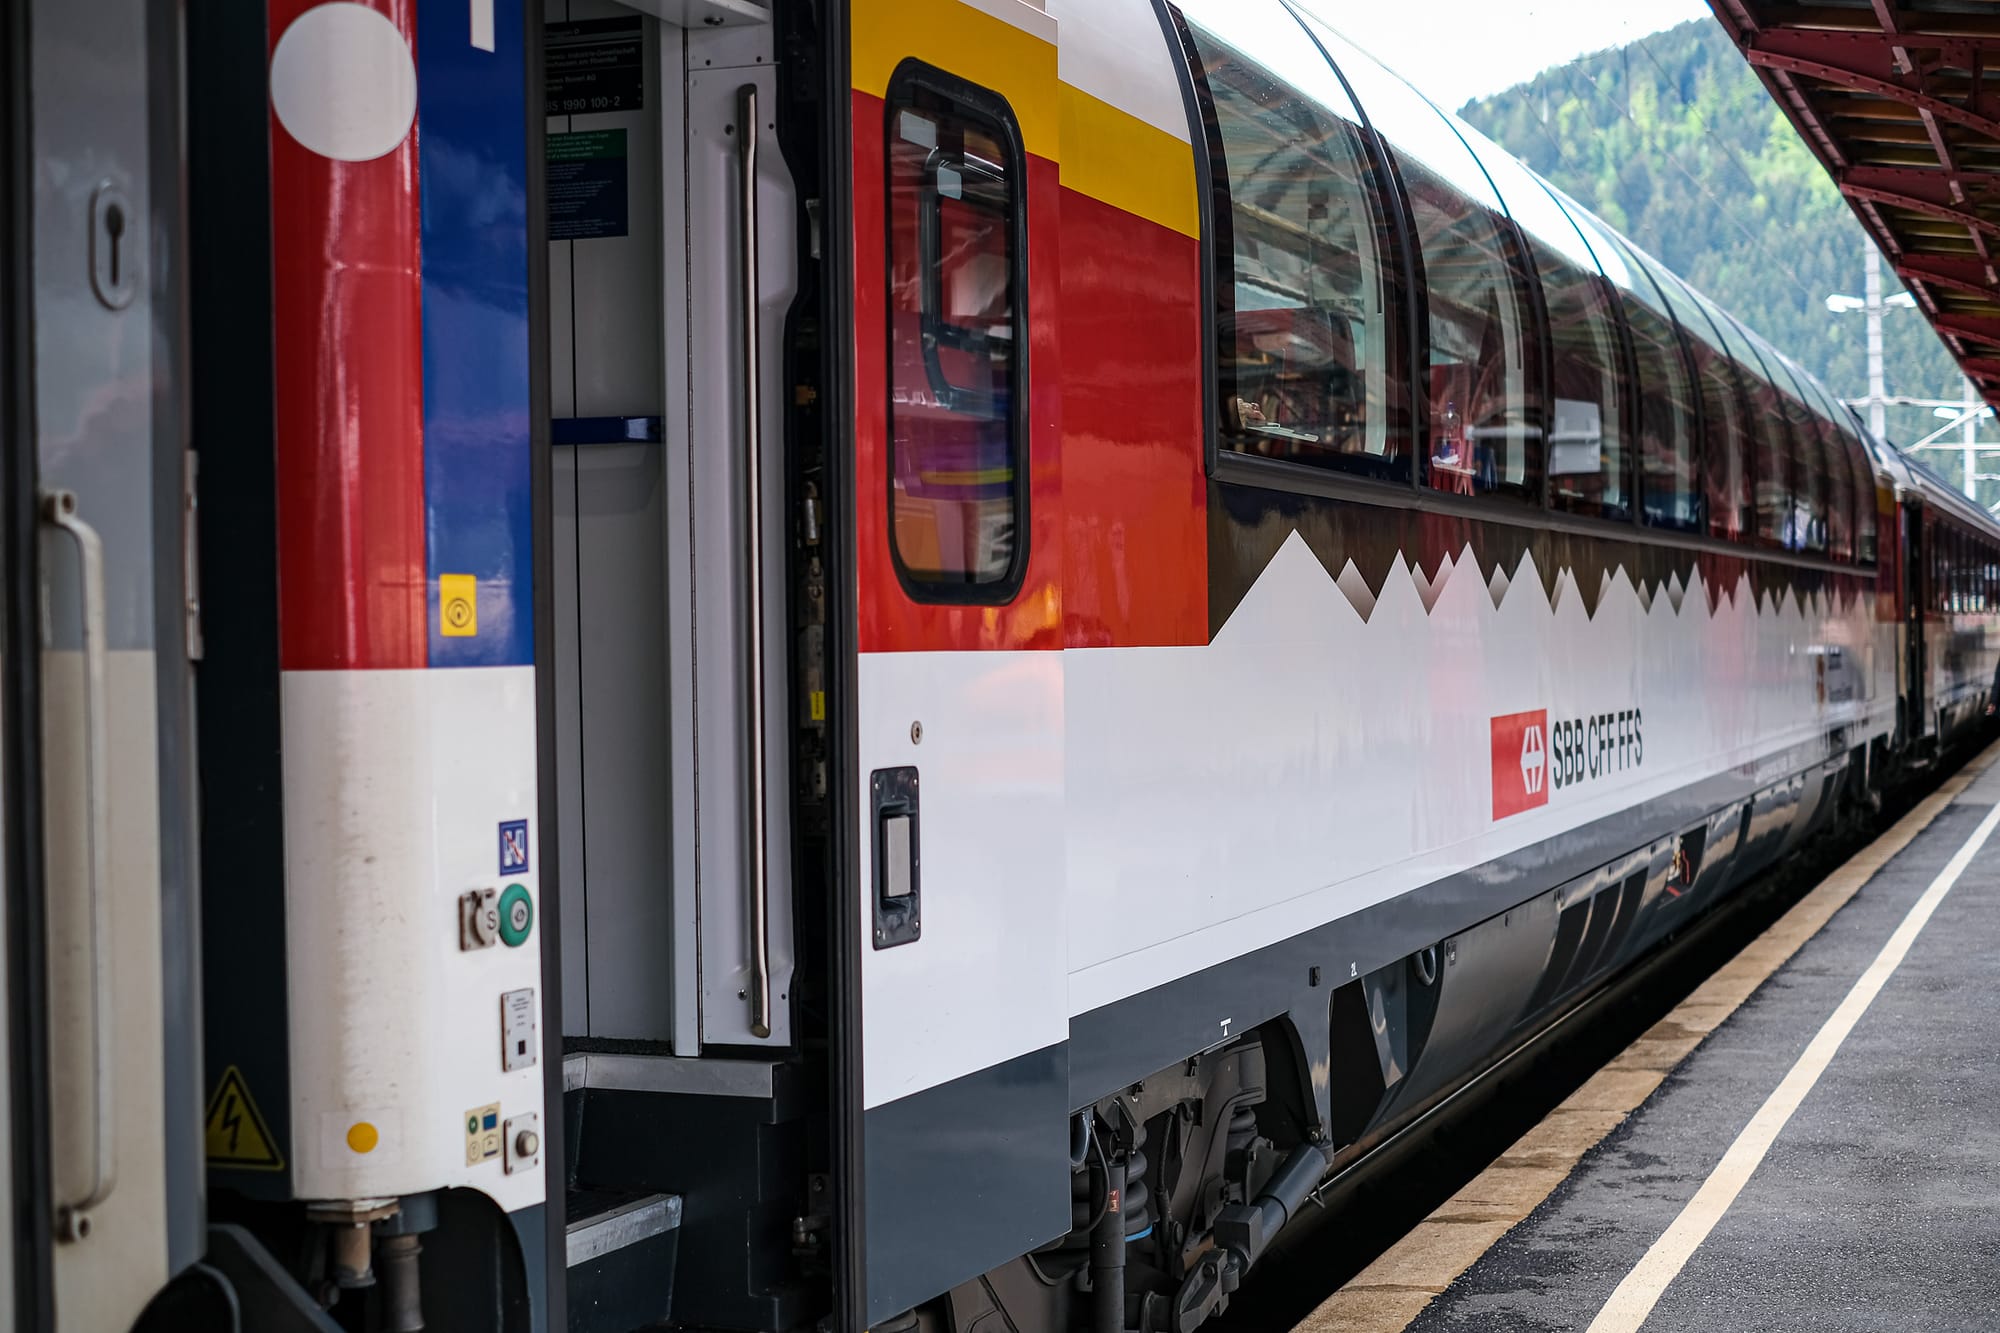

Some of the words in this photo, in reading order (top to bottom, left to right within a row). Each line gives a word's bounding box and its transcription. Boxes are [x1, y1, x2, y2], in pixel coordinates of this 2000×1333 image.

[563, 98, 586, 110] 1990
[1553, 719, 1585, 790] SBB
[1588, 714, 1614, 780] CFF
[1618, 707, 1643, 771] FFS
